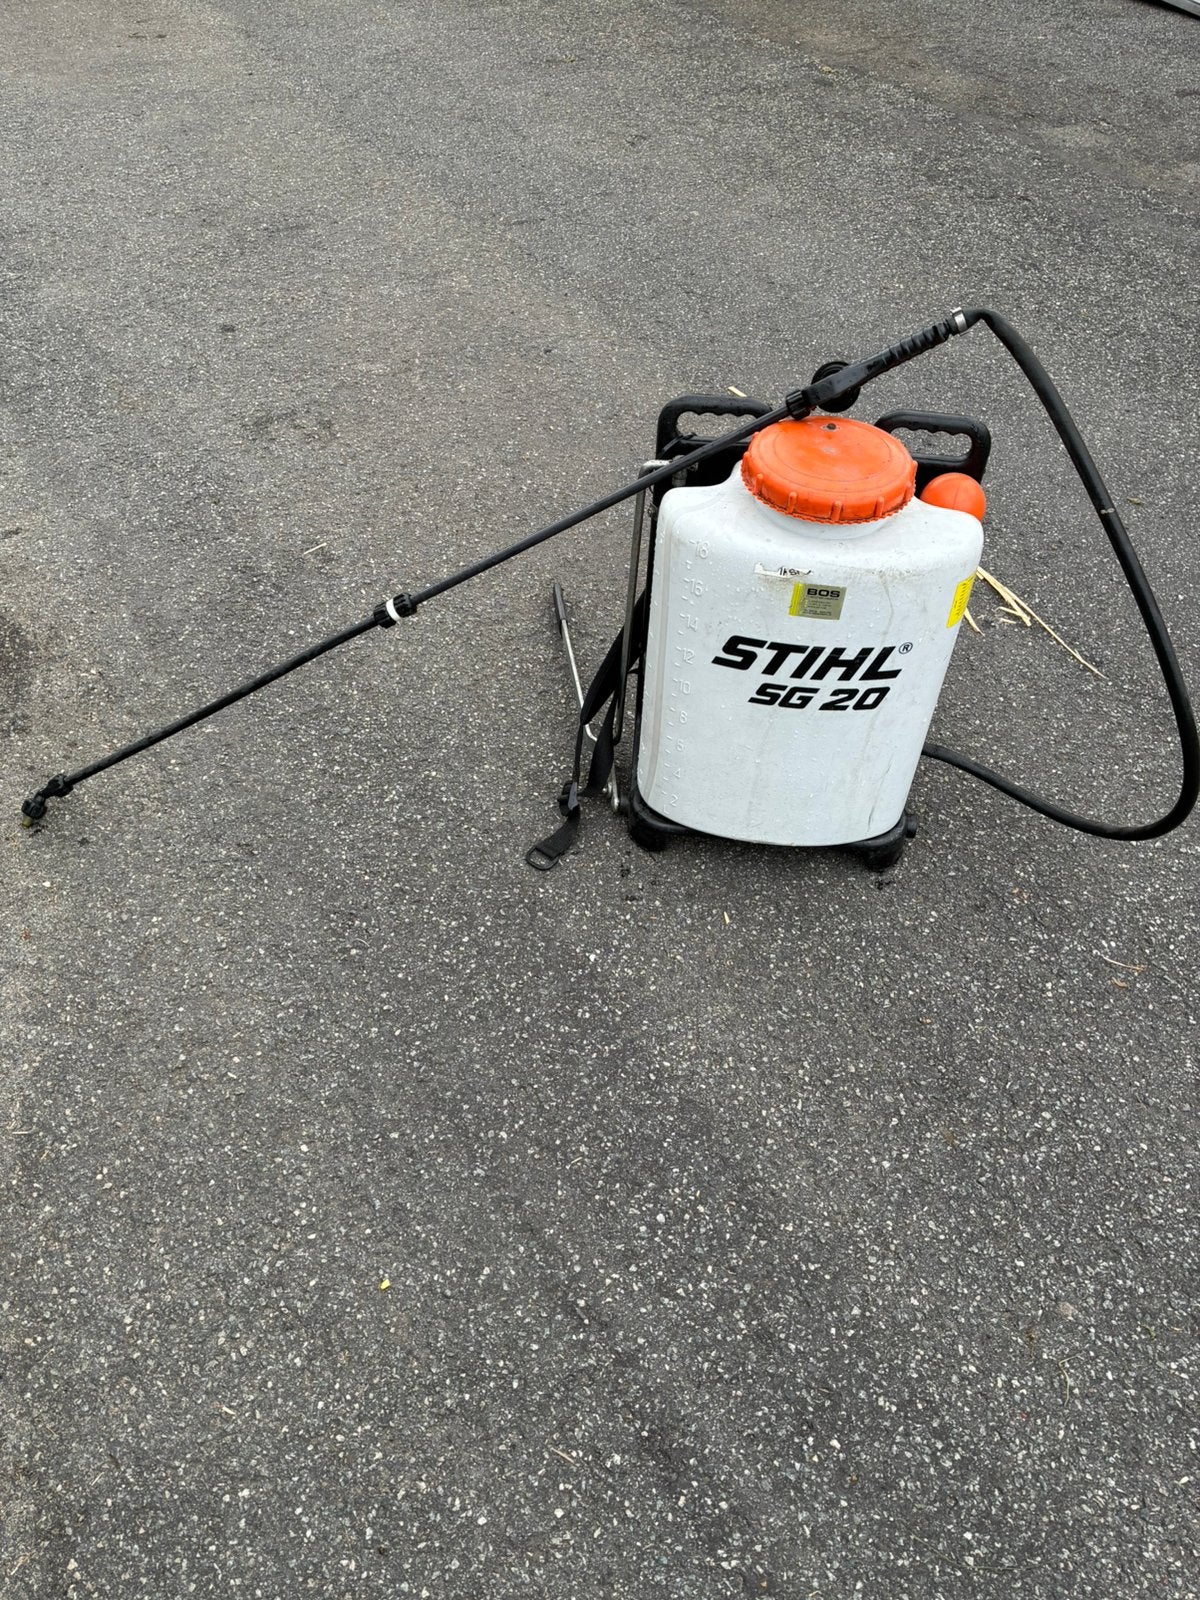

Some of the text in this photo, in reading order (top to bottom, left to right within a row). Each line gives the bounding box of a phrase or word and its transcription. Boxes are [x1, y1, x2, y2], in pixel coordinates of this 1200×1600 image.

[690, 578, 703, 597] 16
[806, 588, 841, 598] BOS
[686, 614, 698, 632] 14
[683, 647, 695, 664] 12
[679, 679, 691, 695] 10
[748, 682, 891, 711] SG 20
[670, 793, 679, 807] 2
